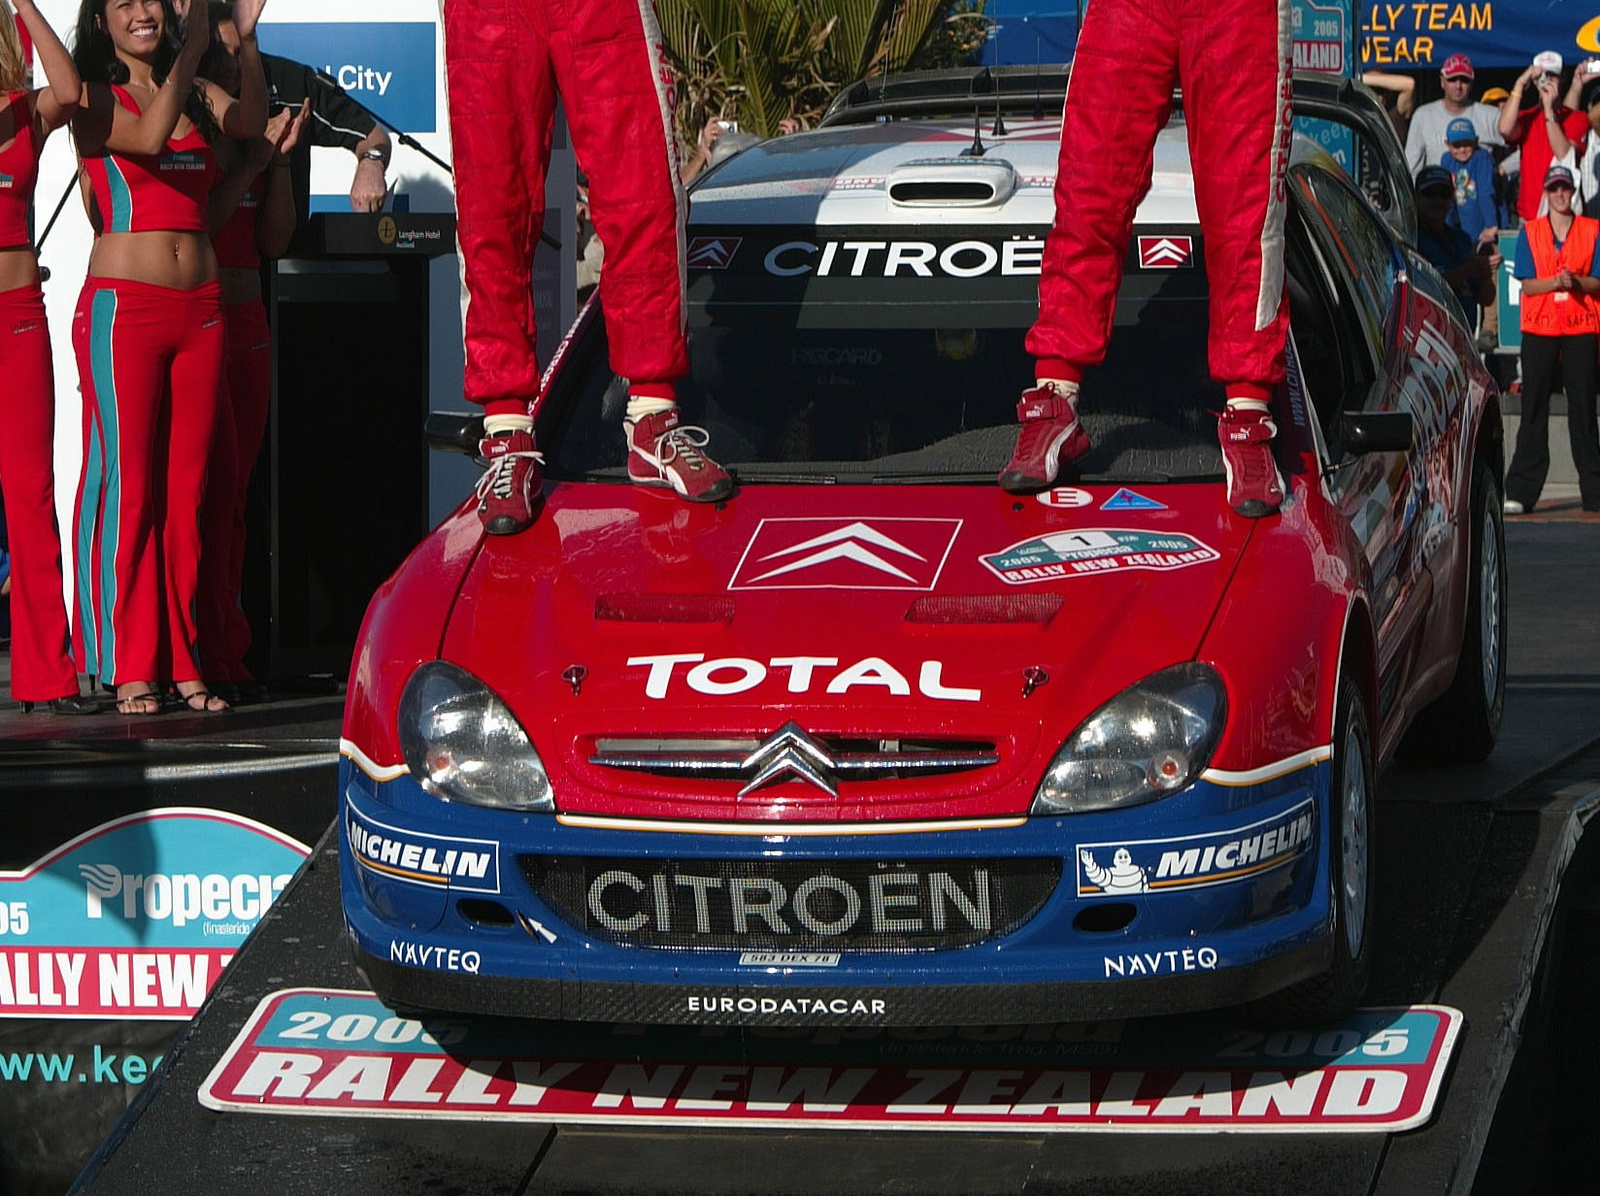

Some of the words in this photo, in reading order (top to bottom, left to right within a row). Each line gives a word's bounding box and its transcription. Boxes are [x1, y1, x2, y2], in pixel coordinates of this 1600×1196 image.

[1314, 20, 1340, 37] 2005
[1412, 2, 1493, 31] TEAM
[1292, 42, 1340, 69] ALAND
[338, 64, 393, 95] City
[764, 234, 1044, 278] CITROË
[1050, 490, 1079, 505] E
[1000, 555, 1042, 568] 2005
[1148, 540, 1189, 550] 2005
[1070, 536, 1092, 546] 1
[1005, 564, 1067, 582] RALLY
[1071, 557, 1119, 573] NEW
[1123, 548, 1212, 567] ZEALAND
[626, 653, 982, 702] TOTAL
[351, 819, 492, 879] MICHELIN
[1156, 811, 1313, 879] MICHELIN
[588, 863, 992, 937] CITROËN
[0, 902, 29, 936] 05
[389, 939, 482, 975] NAVTEQ
[1104, 946, 1218, 978] NAVTEQ
[0, 953, 87, 1007] ALLY
[99, 953, 209, 1008] NEW
[688, 996, 886, 1015] EURODATACAR
[279, 1011, 469, 1046] 2005
[1216, 1027, 1410, 1059] 2005
[233, 1051, 584, 1106] RALLY
[590, 1061, 869, 1111] NEW
[886, 1069, 1409, 1117] ZEALAND
